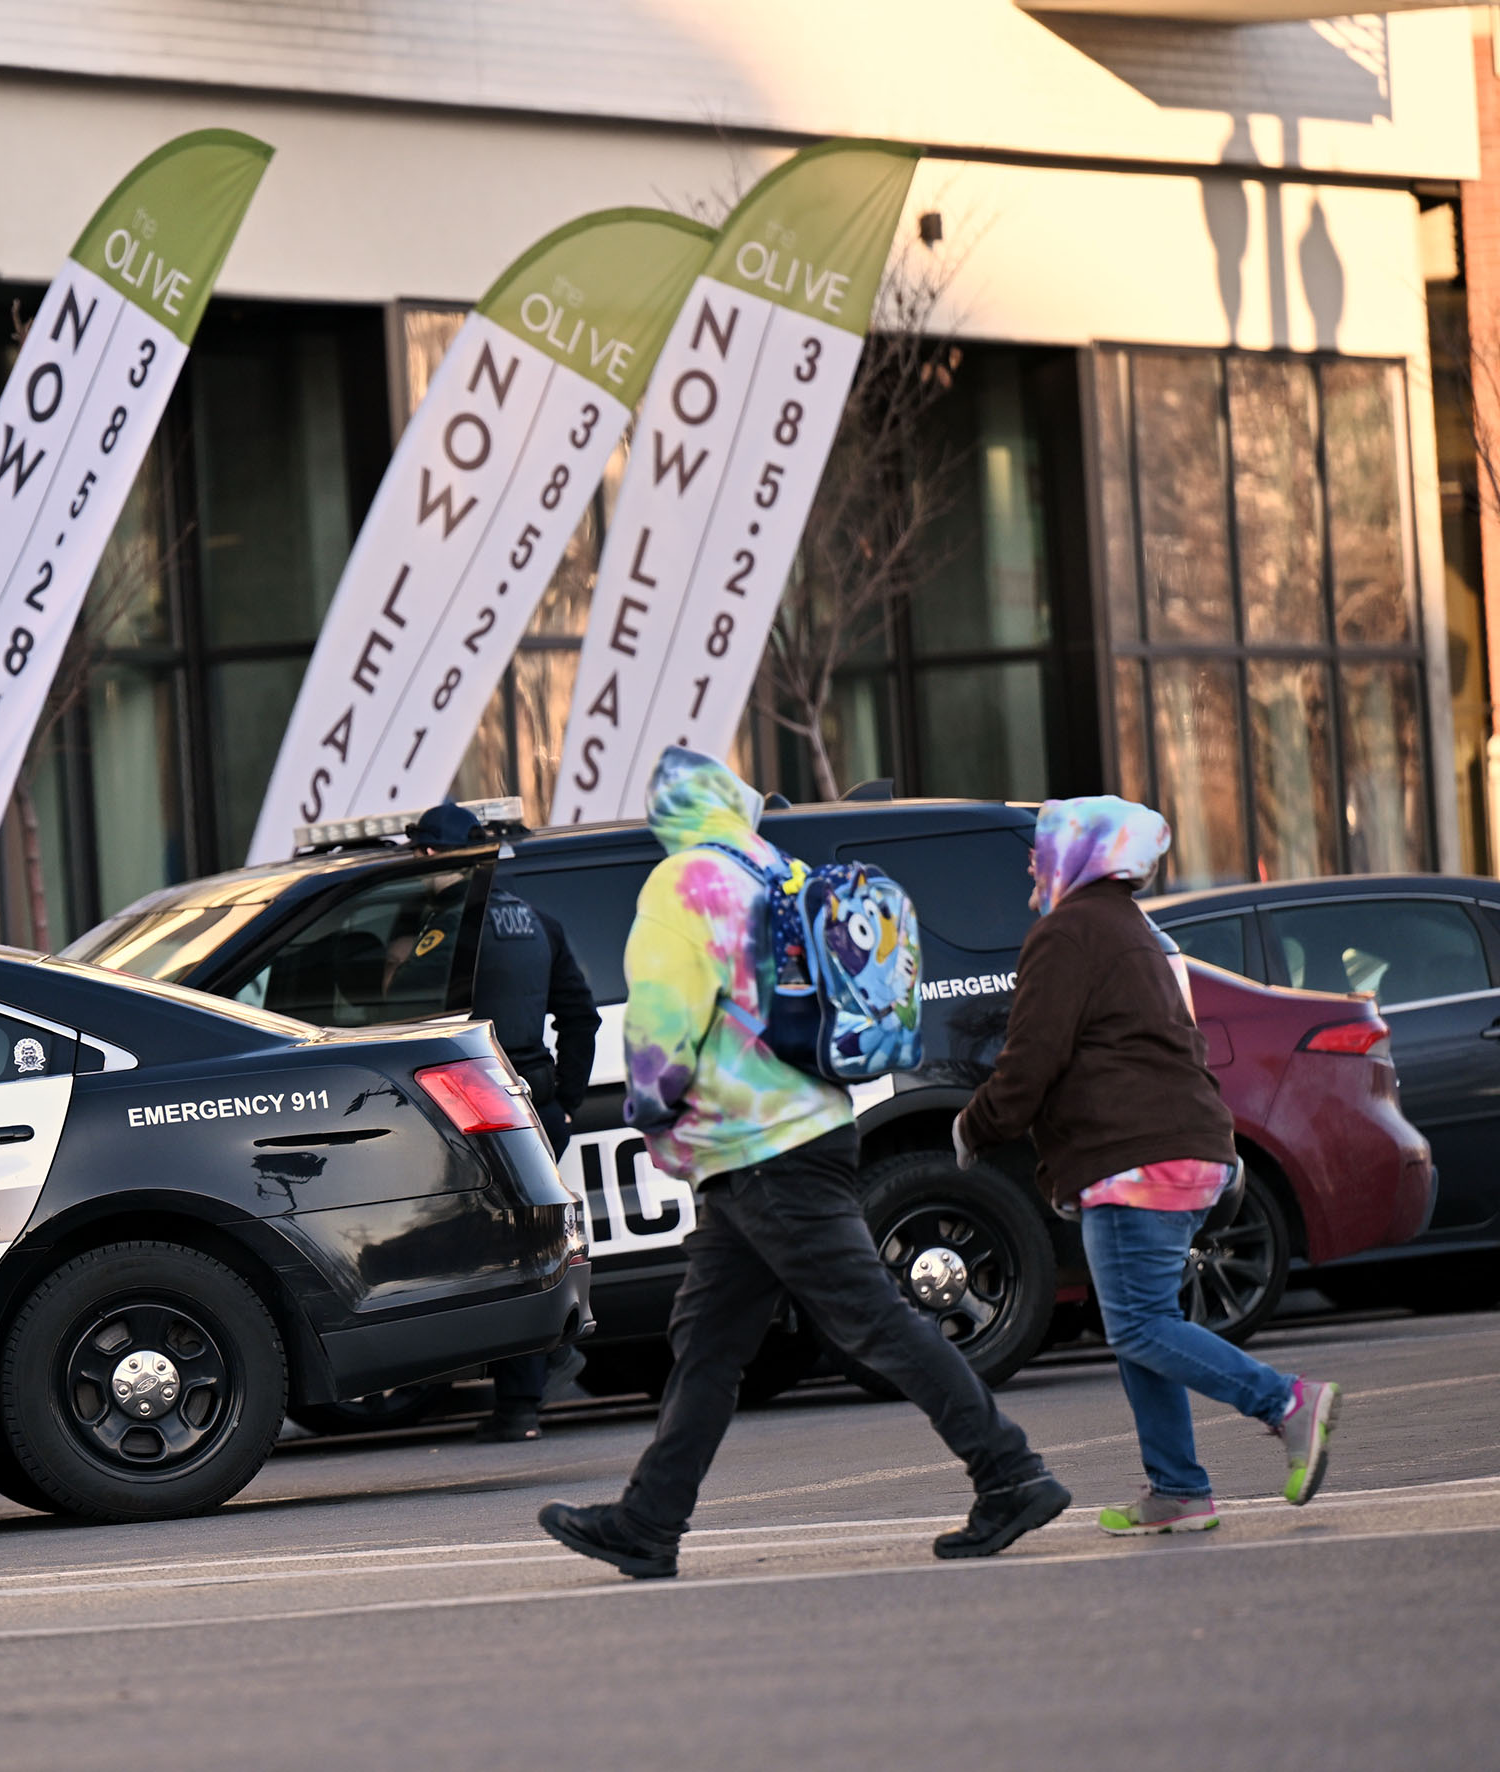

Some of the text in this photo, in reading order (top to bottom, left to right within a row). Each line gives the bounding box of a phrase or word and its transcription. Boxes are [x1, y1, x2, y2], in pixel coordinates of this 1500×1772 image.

[104, 228, 192, 316] OLIVE
[735, 241, 851, 315] OLIVE
[520, 293, 635, 385] OLIVE
[416, 338, 520, 543] NOW
[572, 294, 740, 824] NOW LEAS
[489, 906, 535, 935] POLICE
[919, 971, 1018, 1001] MERGENC
[127, 1089, 330, 1128] EMERGENCY 911
